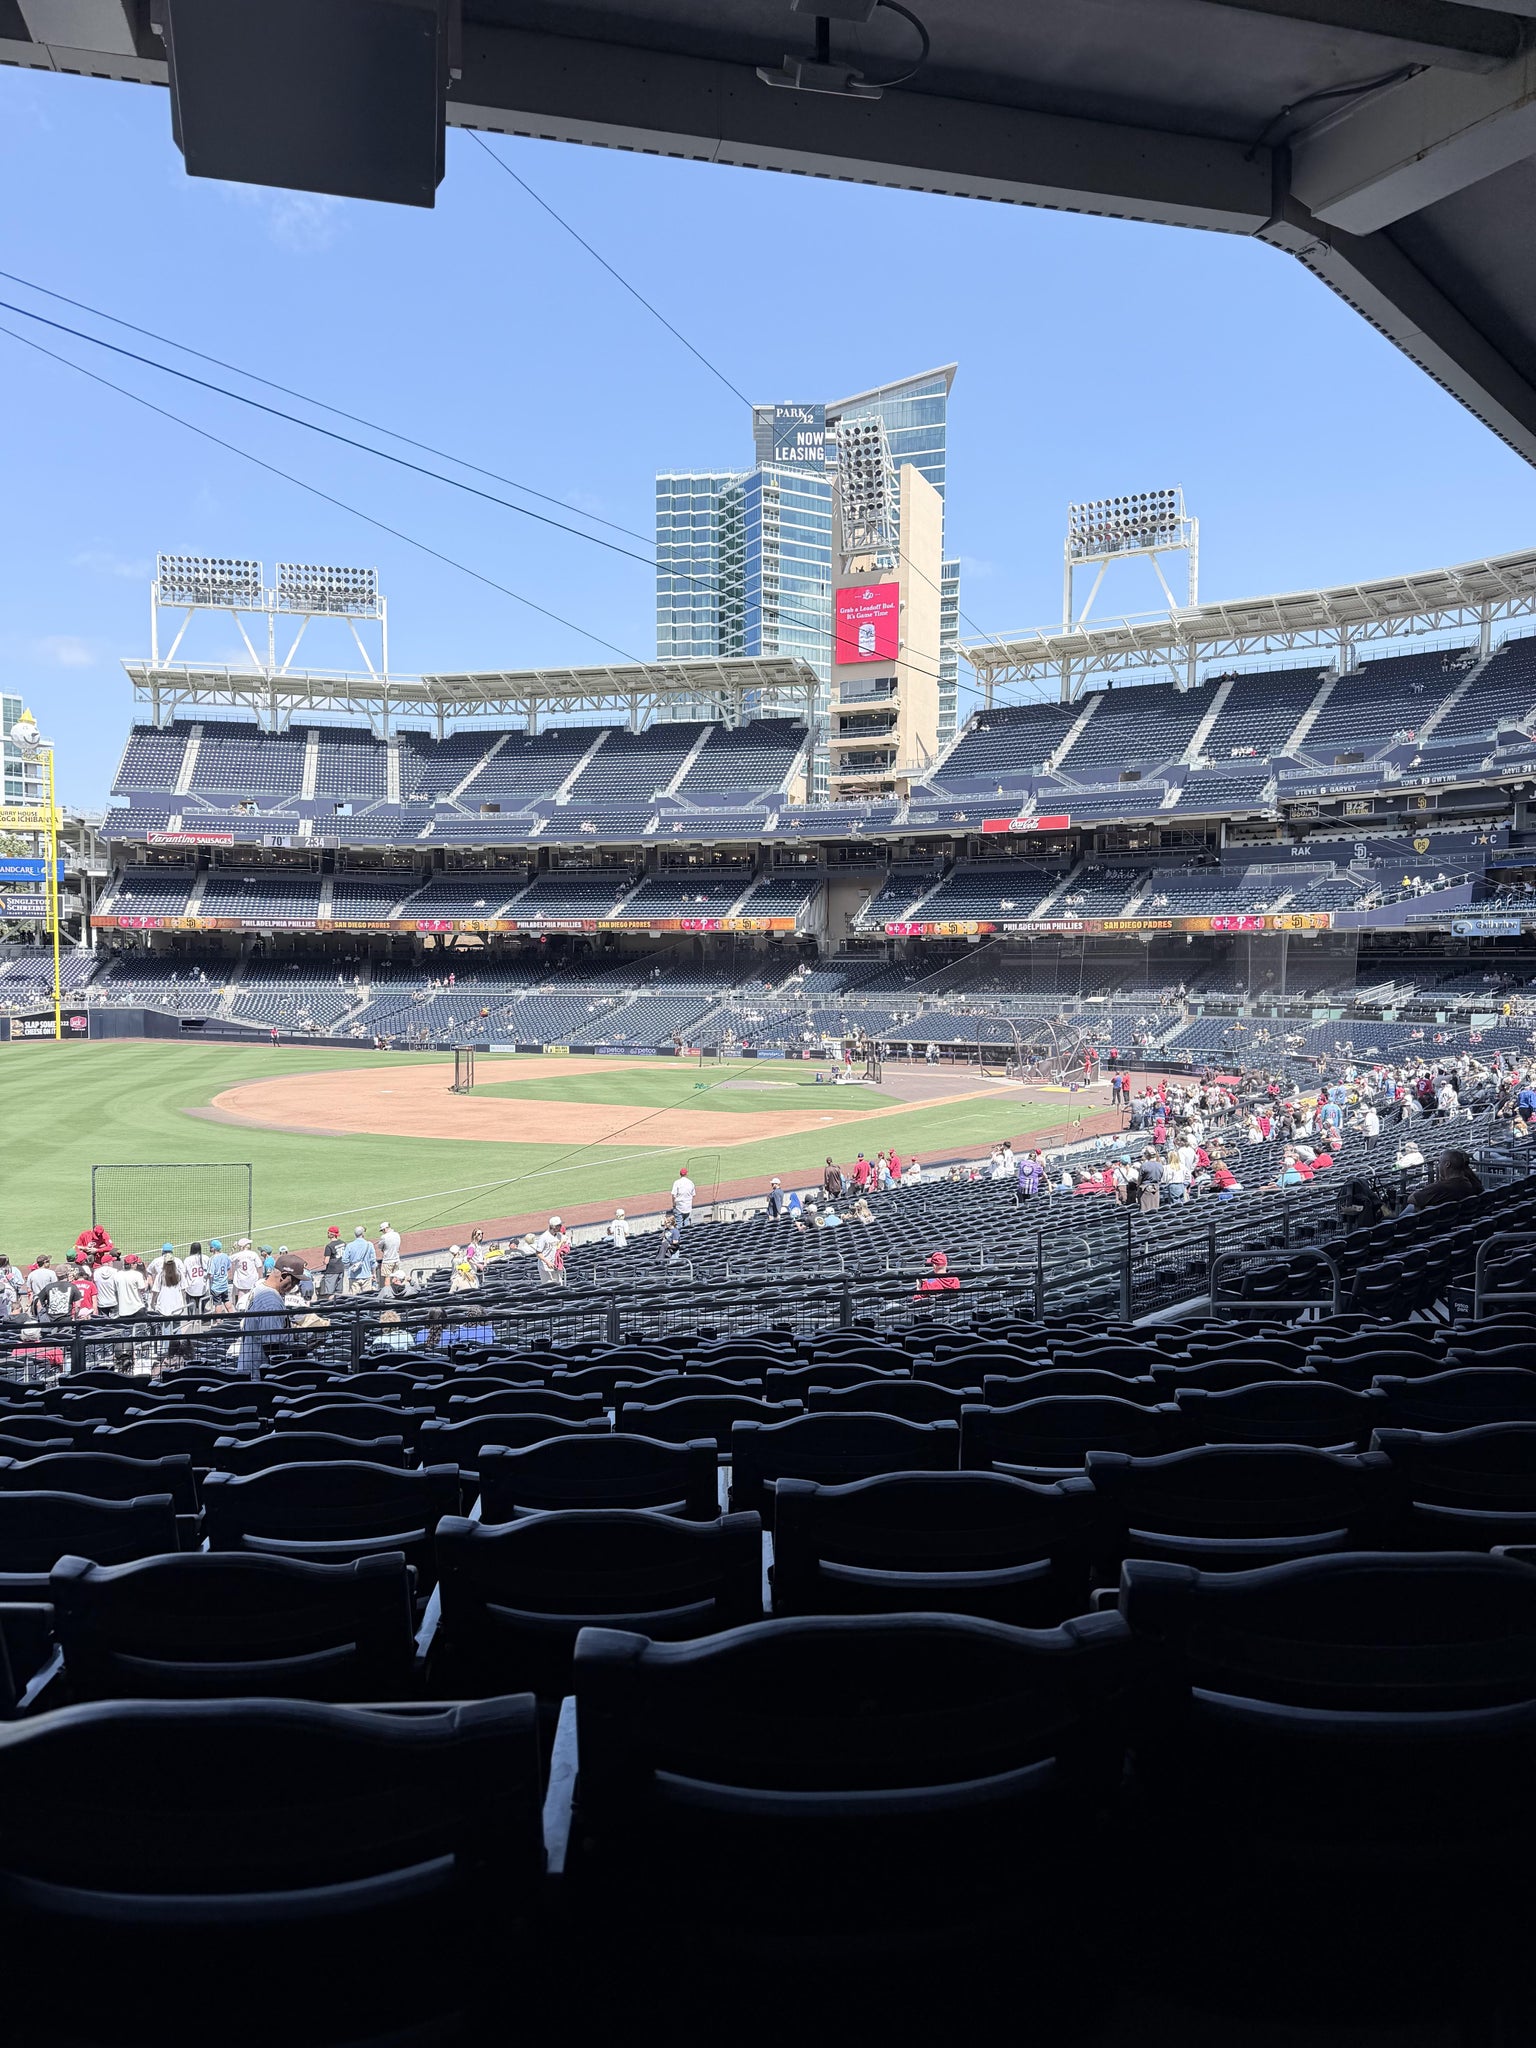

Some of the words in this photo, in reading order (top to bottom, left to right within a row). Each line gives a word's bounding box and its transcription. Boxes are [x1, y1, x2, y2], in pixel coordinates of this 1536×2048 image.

[776, 408, 805, 418] PARK
[797, 432, 824, 446] NOW
[775, 447, 824, 461] LEASING
[1400, 779, 1418, 787] TONY
[1420, 777, 1430, 785] 19
[1431, 775, 1457, 783] GWYNN
[1295, 788, 1317, 796] STEVE
[1320, 786, 1327, 794] 6
[1329, 785, 1357, 793] GARVEY
[150, 832, 195, 844] Tarantino
[196, 837, 232, 845] SAUSAGES
[304, 837, 325, 847] 2:34
[1291, 847, 1311, 856] RAK
[334, 920, 347, 928] SAN
[1003, 923, 1050, 931] PHILADELPHIA
[1052, 922, 1083, 930] PHILLIES
[1103, 922, 1119, 930] SAN
[1119, 921, 1142, 929] DIEGO
[1142, 920, 1172, 929] PADRES
[24, 1021, 39, 1029] SLAP
[24, 1028, 42, 1036] CHEESE
[637, 1047, 657, 1055] petco
[242, 1261, 248, 1271] 8
[191, 1267, 204, 1278] 26
